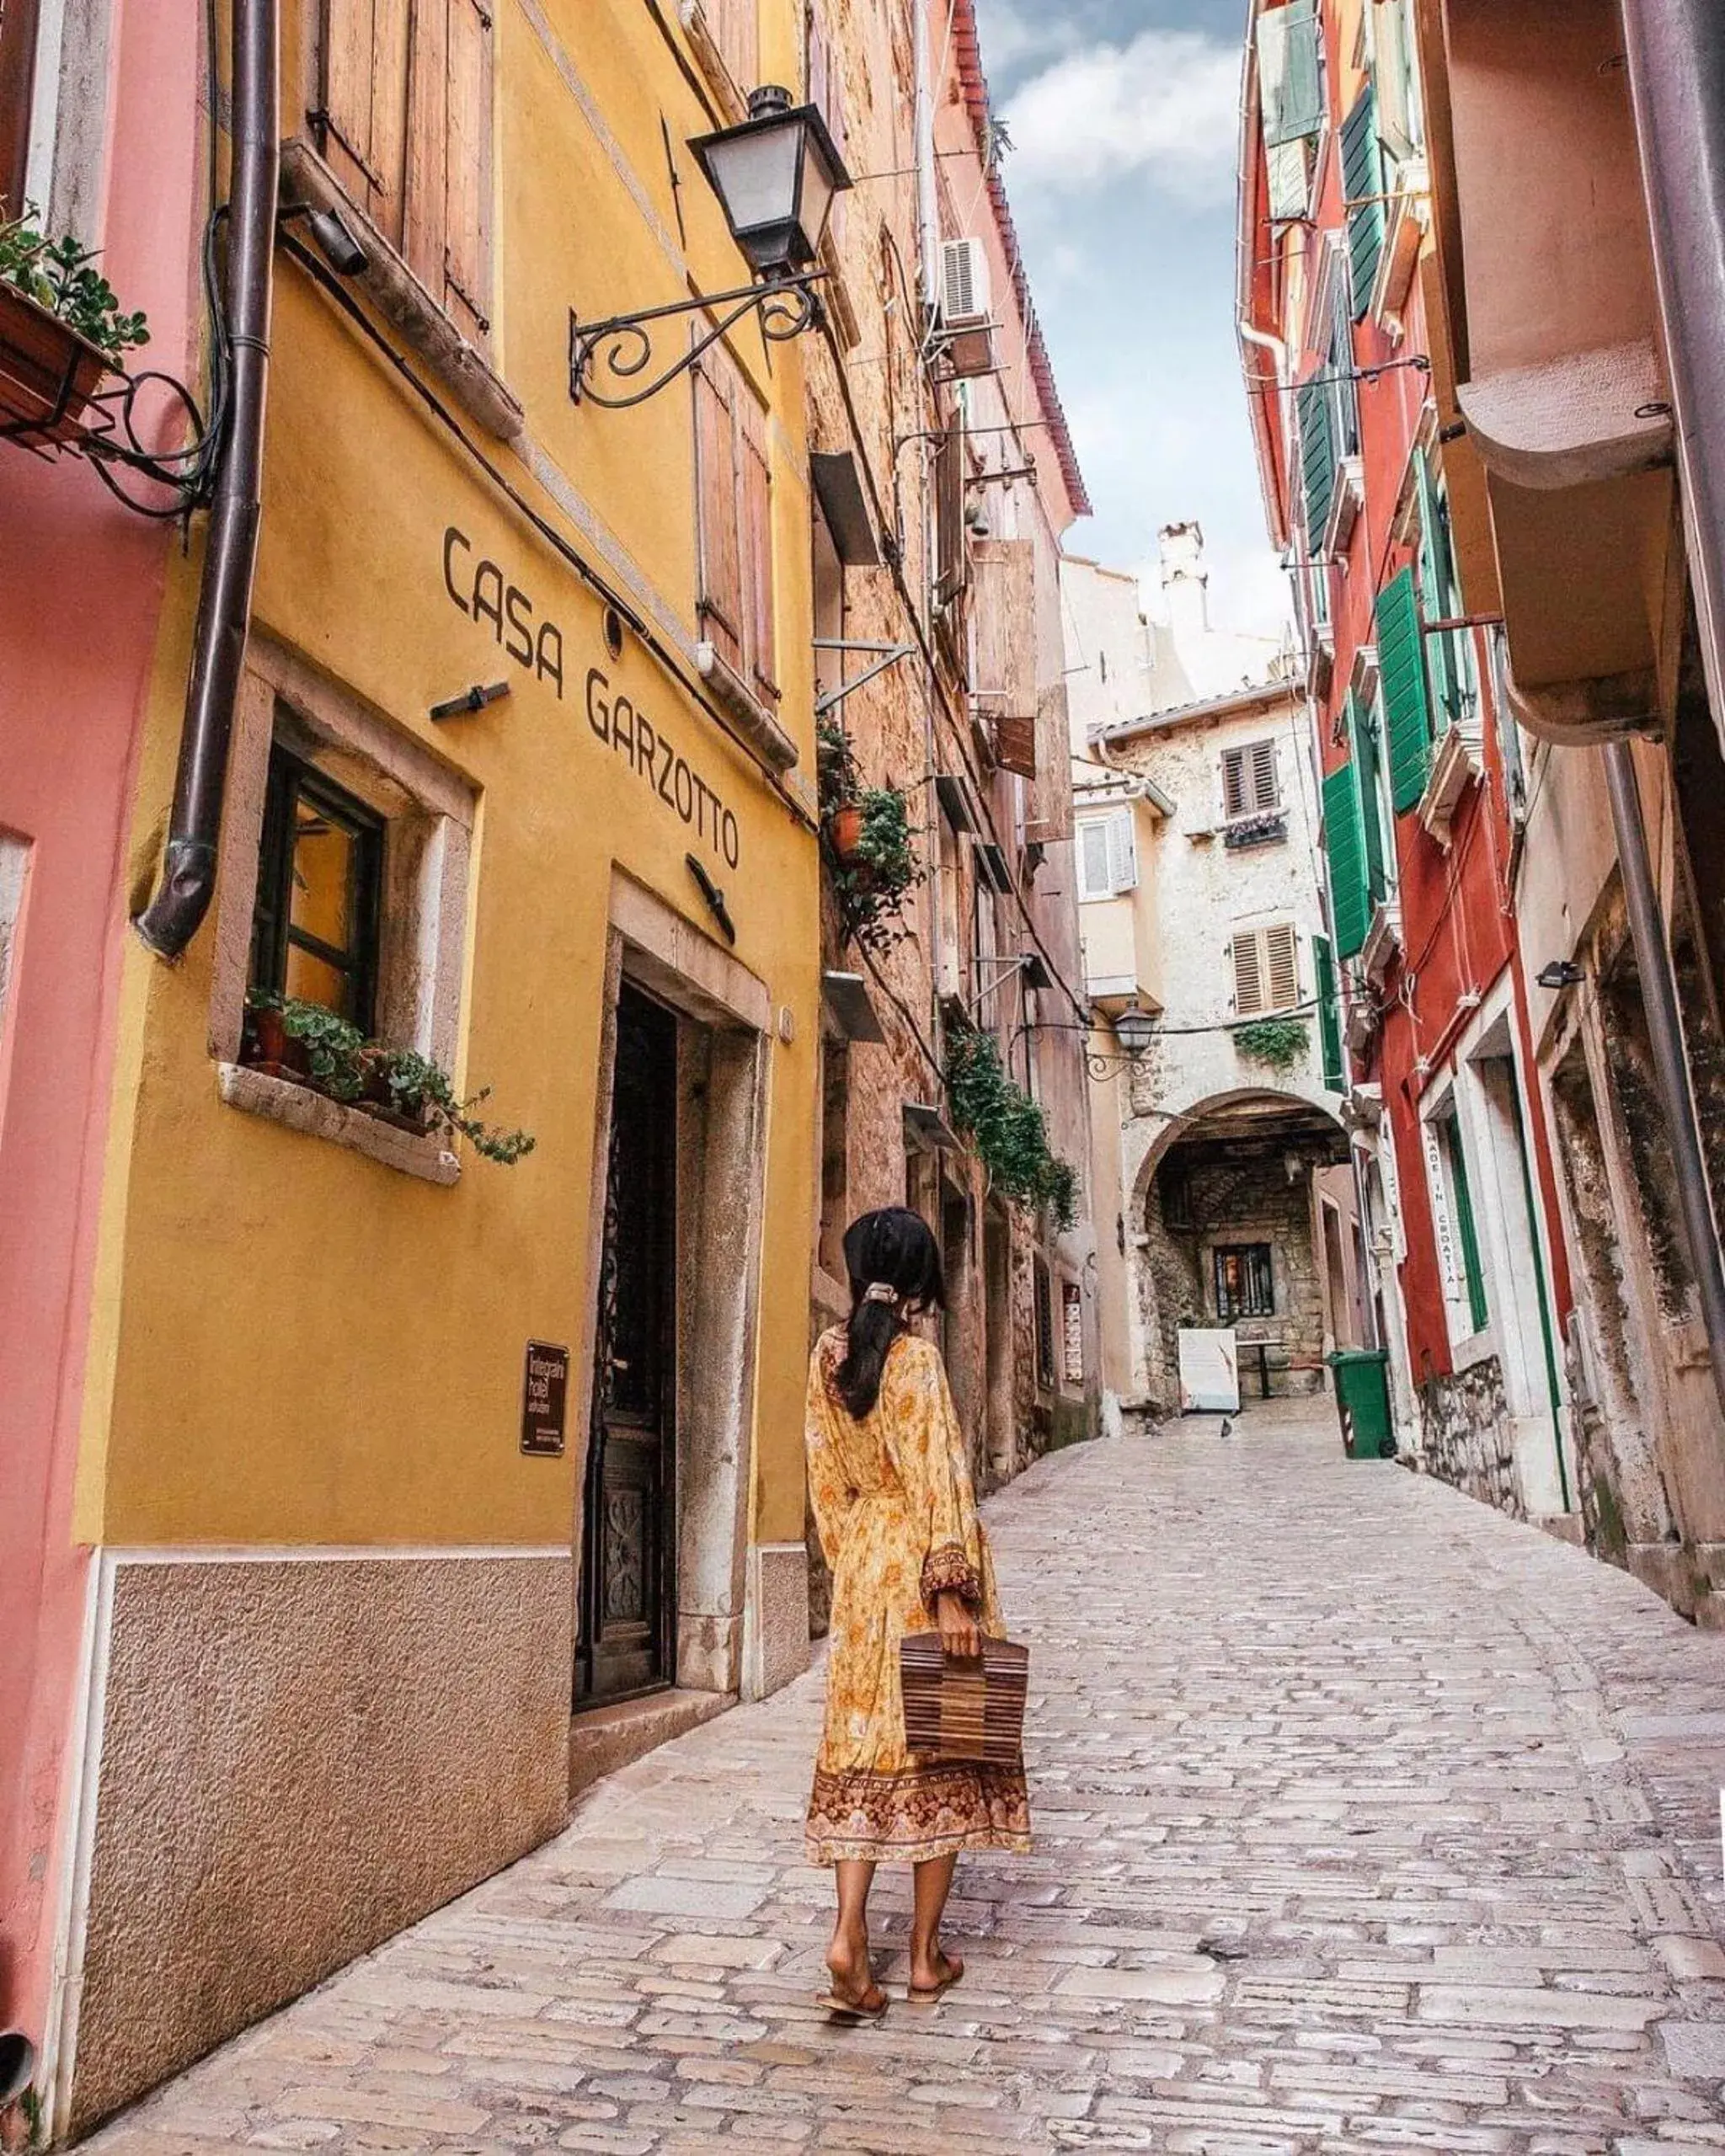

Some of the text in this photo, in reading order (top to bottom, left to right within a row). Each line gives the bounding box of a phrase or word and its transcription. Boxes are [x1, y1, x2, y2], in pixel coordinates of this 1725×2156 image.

[443, 526, 739, 870] CASA GARZOTTO
[1427, 1134, 1455, 1283] MADE IN CROATIA
